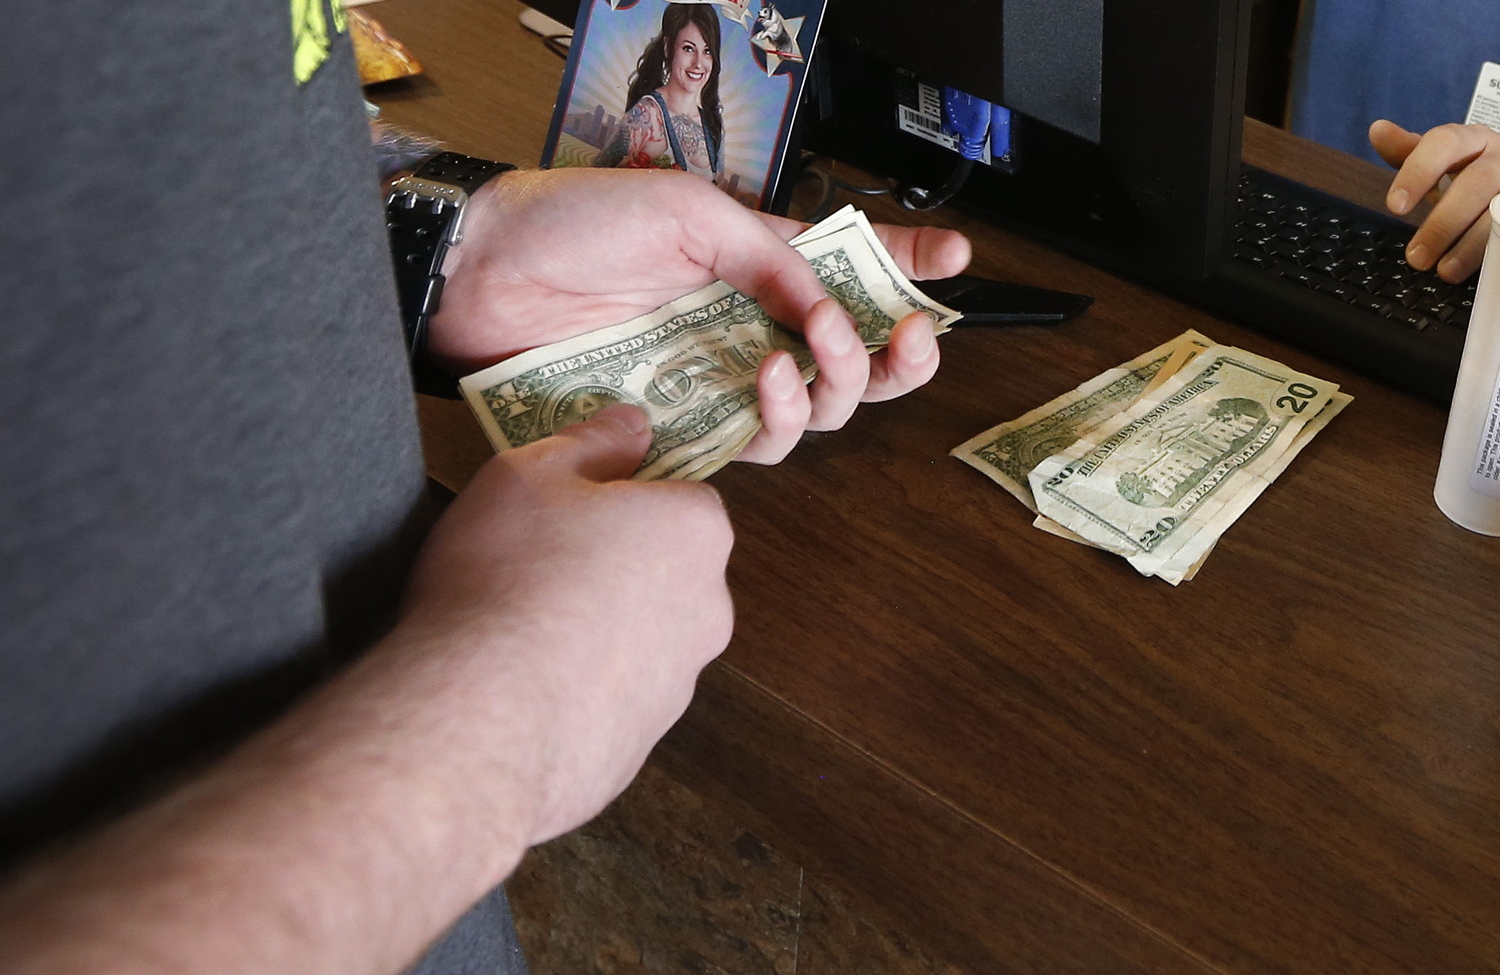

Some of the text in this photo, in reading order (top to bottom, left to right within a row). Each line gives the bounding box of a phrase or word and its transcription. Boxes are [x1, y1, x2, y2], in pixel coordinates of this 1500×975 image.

[819, 259, 850, 279] ONE
[537, 296, 735, 382] THE UNITED STATES OF
[1201, 358, 1224, 379] 20
[490, 386, 532, 412] ONE
[1275, 382, 1319, 414] 20
[1077, 456, 1102, 478] THE
[1167, 379, 1219, 411] AMERICA
[1487, 413, 1497, 433] sealed
[1479, 439, 1492, 463] package
[1489, 442, 1497, 454] This
[1048, 467, 1074, 488] 20
[1476, 462, 1484, 474] This
[1139, 514, 1178, 549] 20
